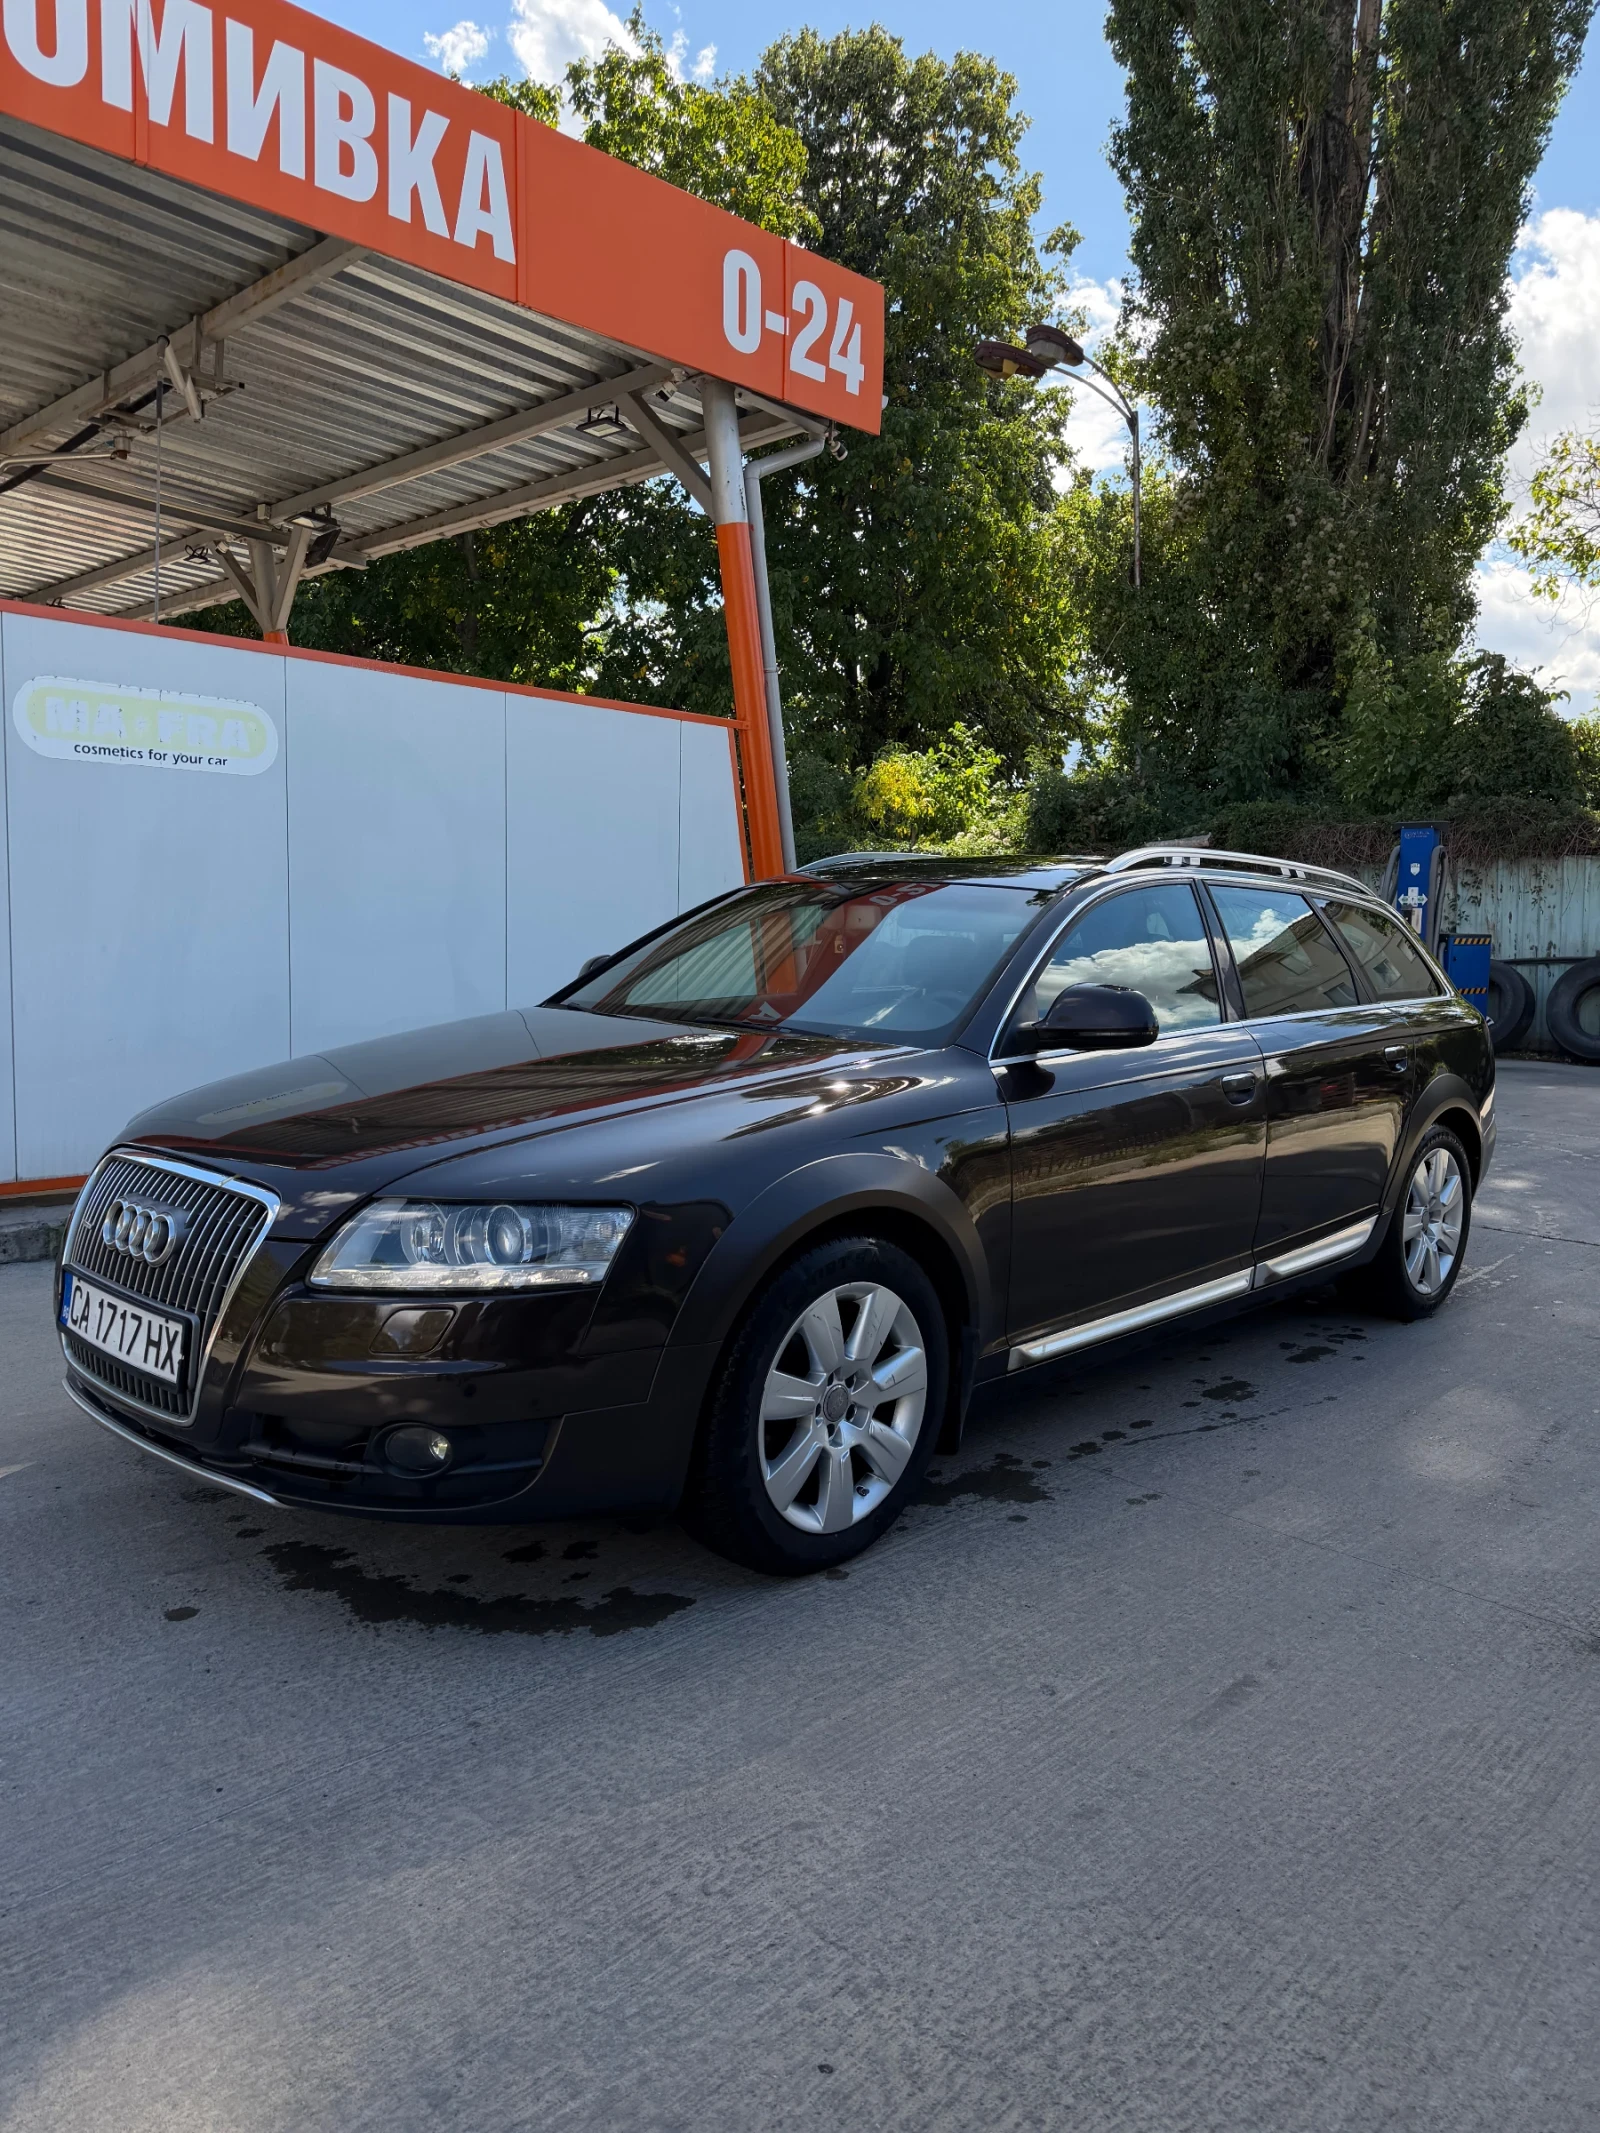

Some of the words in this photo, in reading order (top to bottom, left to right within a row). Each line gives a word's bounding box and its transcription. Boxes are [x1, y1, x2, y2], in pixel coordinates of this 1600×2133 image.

[723, 249, 865, 396] 0-24
[74, 743, 144, 759] cosmetics
[148, 748, 168, 761] for
[172, 752, 203, 765] your
[207, 756, 228, 766] car
[70, 1284, 91, 1335] CA
[95, 1298, 143, 1356] 1717
[143, 1319, 180, 1376] HX
